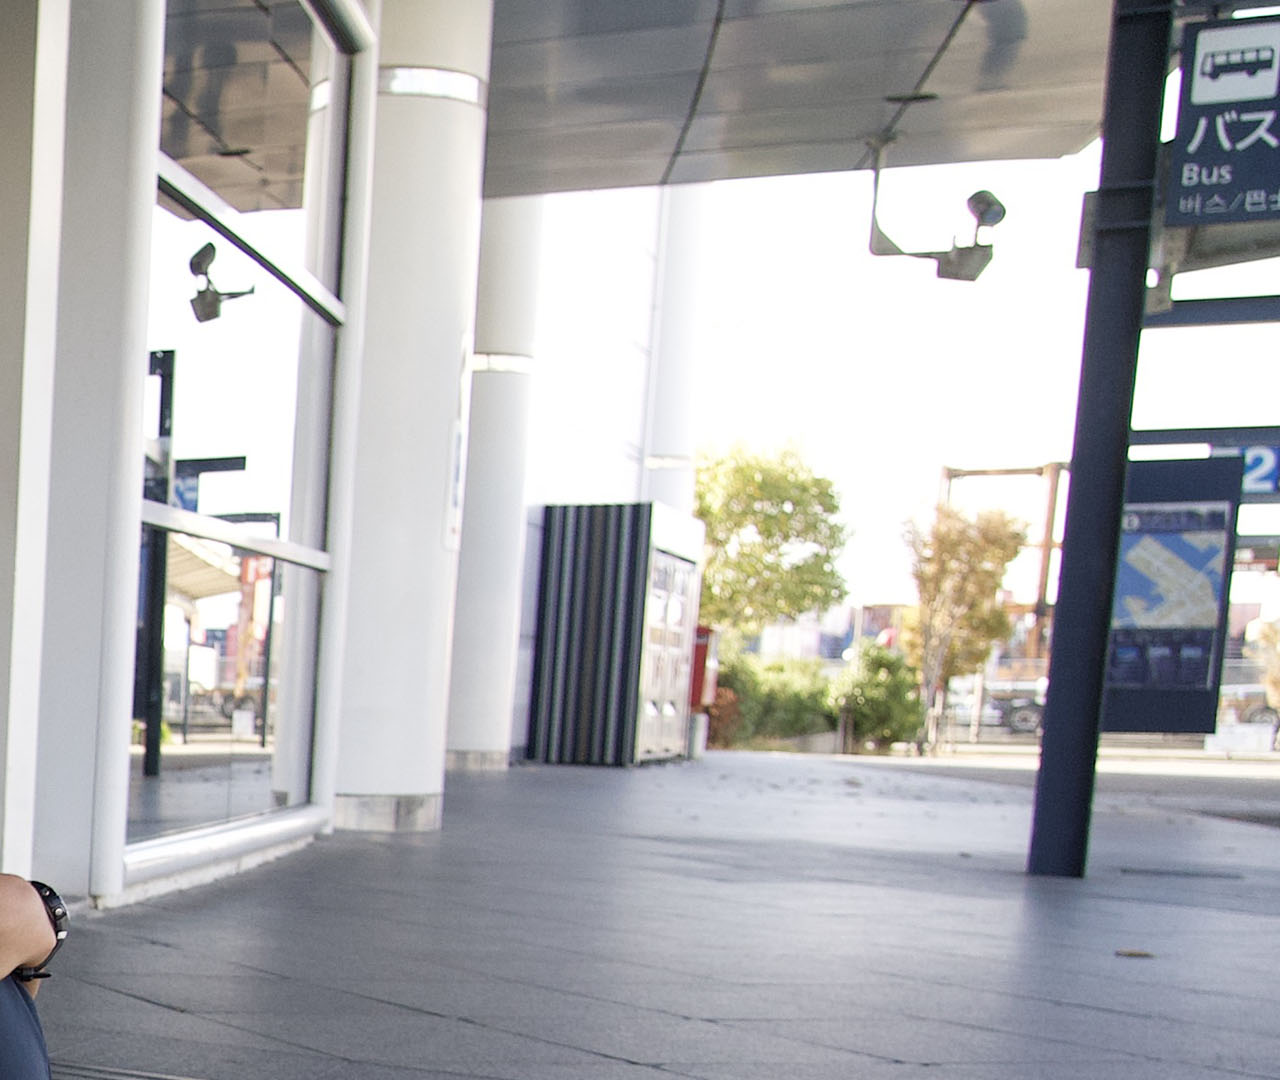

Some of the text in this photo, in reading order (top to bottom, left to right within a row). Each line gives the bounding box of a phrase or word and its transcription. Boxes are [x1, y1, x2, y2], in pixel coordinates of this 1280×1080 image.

[1187, 110, 1279, 154] バス
[1181, 163, 1233, 187] Bus
[1242, 447, 1275, 493] 2
